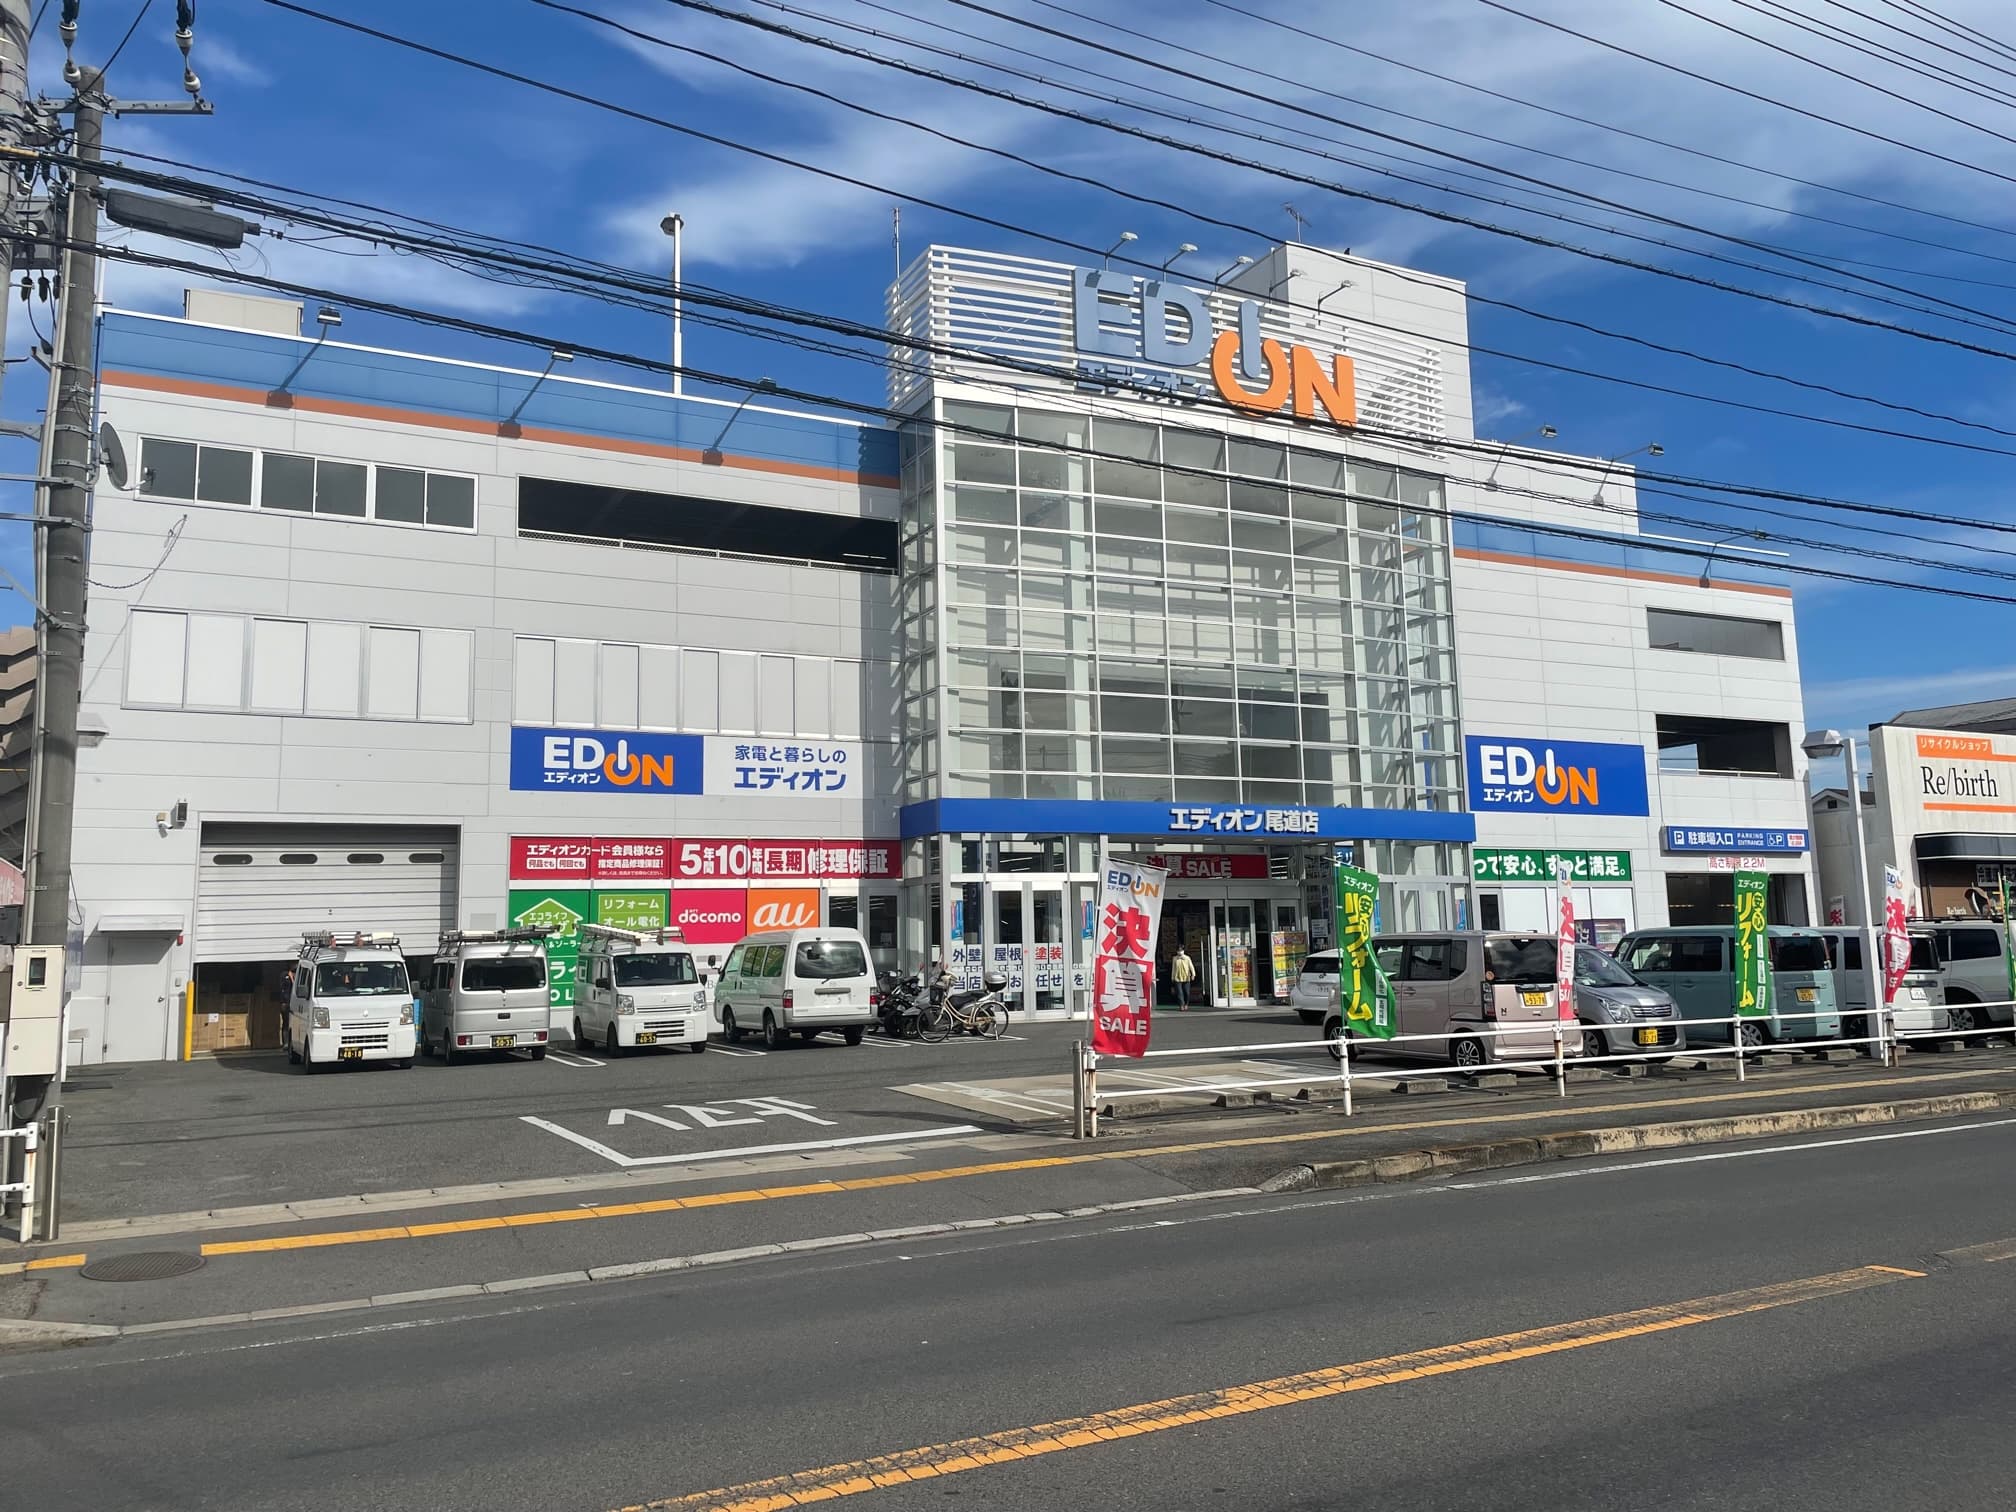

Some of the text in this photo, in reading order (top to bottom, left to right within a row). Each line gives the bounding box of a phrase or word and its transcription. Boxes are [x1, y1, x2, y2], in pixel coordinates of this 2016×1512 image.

[1075, 268, 1357, 427] EDION
[1920, 738, 1989, 751] リサイクルショップ
[544, 736, 673, 786] EDION
[735, 745, 847, 764] 家電と暮らしの
[544, 772, 600, 784] エディオン
[734, 767, 847, 791] エディオン
[1480, 745, 1599, 806] EDION
[1920, 766, 1999, 797] Re/birth
[1483, 788, 1534, 803] エディオン
[1688, 832, 1734, 845] 駐車場入口
[527, 845, 664, 857] エディオンカード会員様なら
[1107, 870, 1160, 898] EDION
[1344, 876, 1375, 892] エディオン
[604, 899, 659, 909] リフォーム
[529, 912, 568, 920] エコライフ
[604, 916, 660, 927] オール電化
[678, 909, 741, 923] docomo
[753, 902, 815, 927] au
[953, 947, 1062, 963] 外壁 屋根 塗装
[1738, 892, 1755, 1007] リフォーム
[1100, 1016, 1147, 1035] SALE
[607, 1096, 839, 1131] 止マレ
